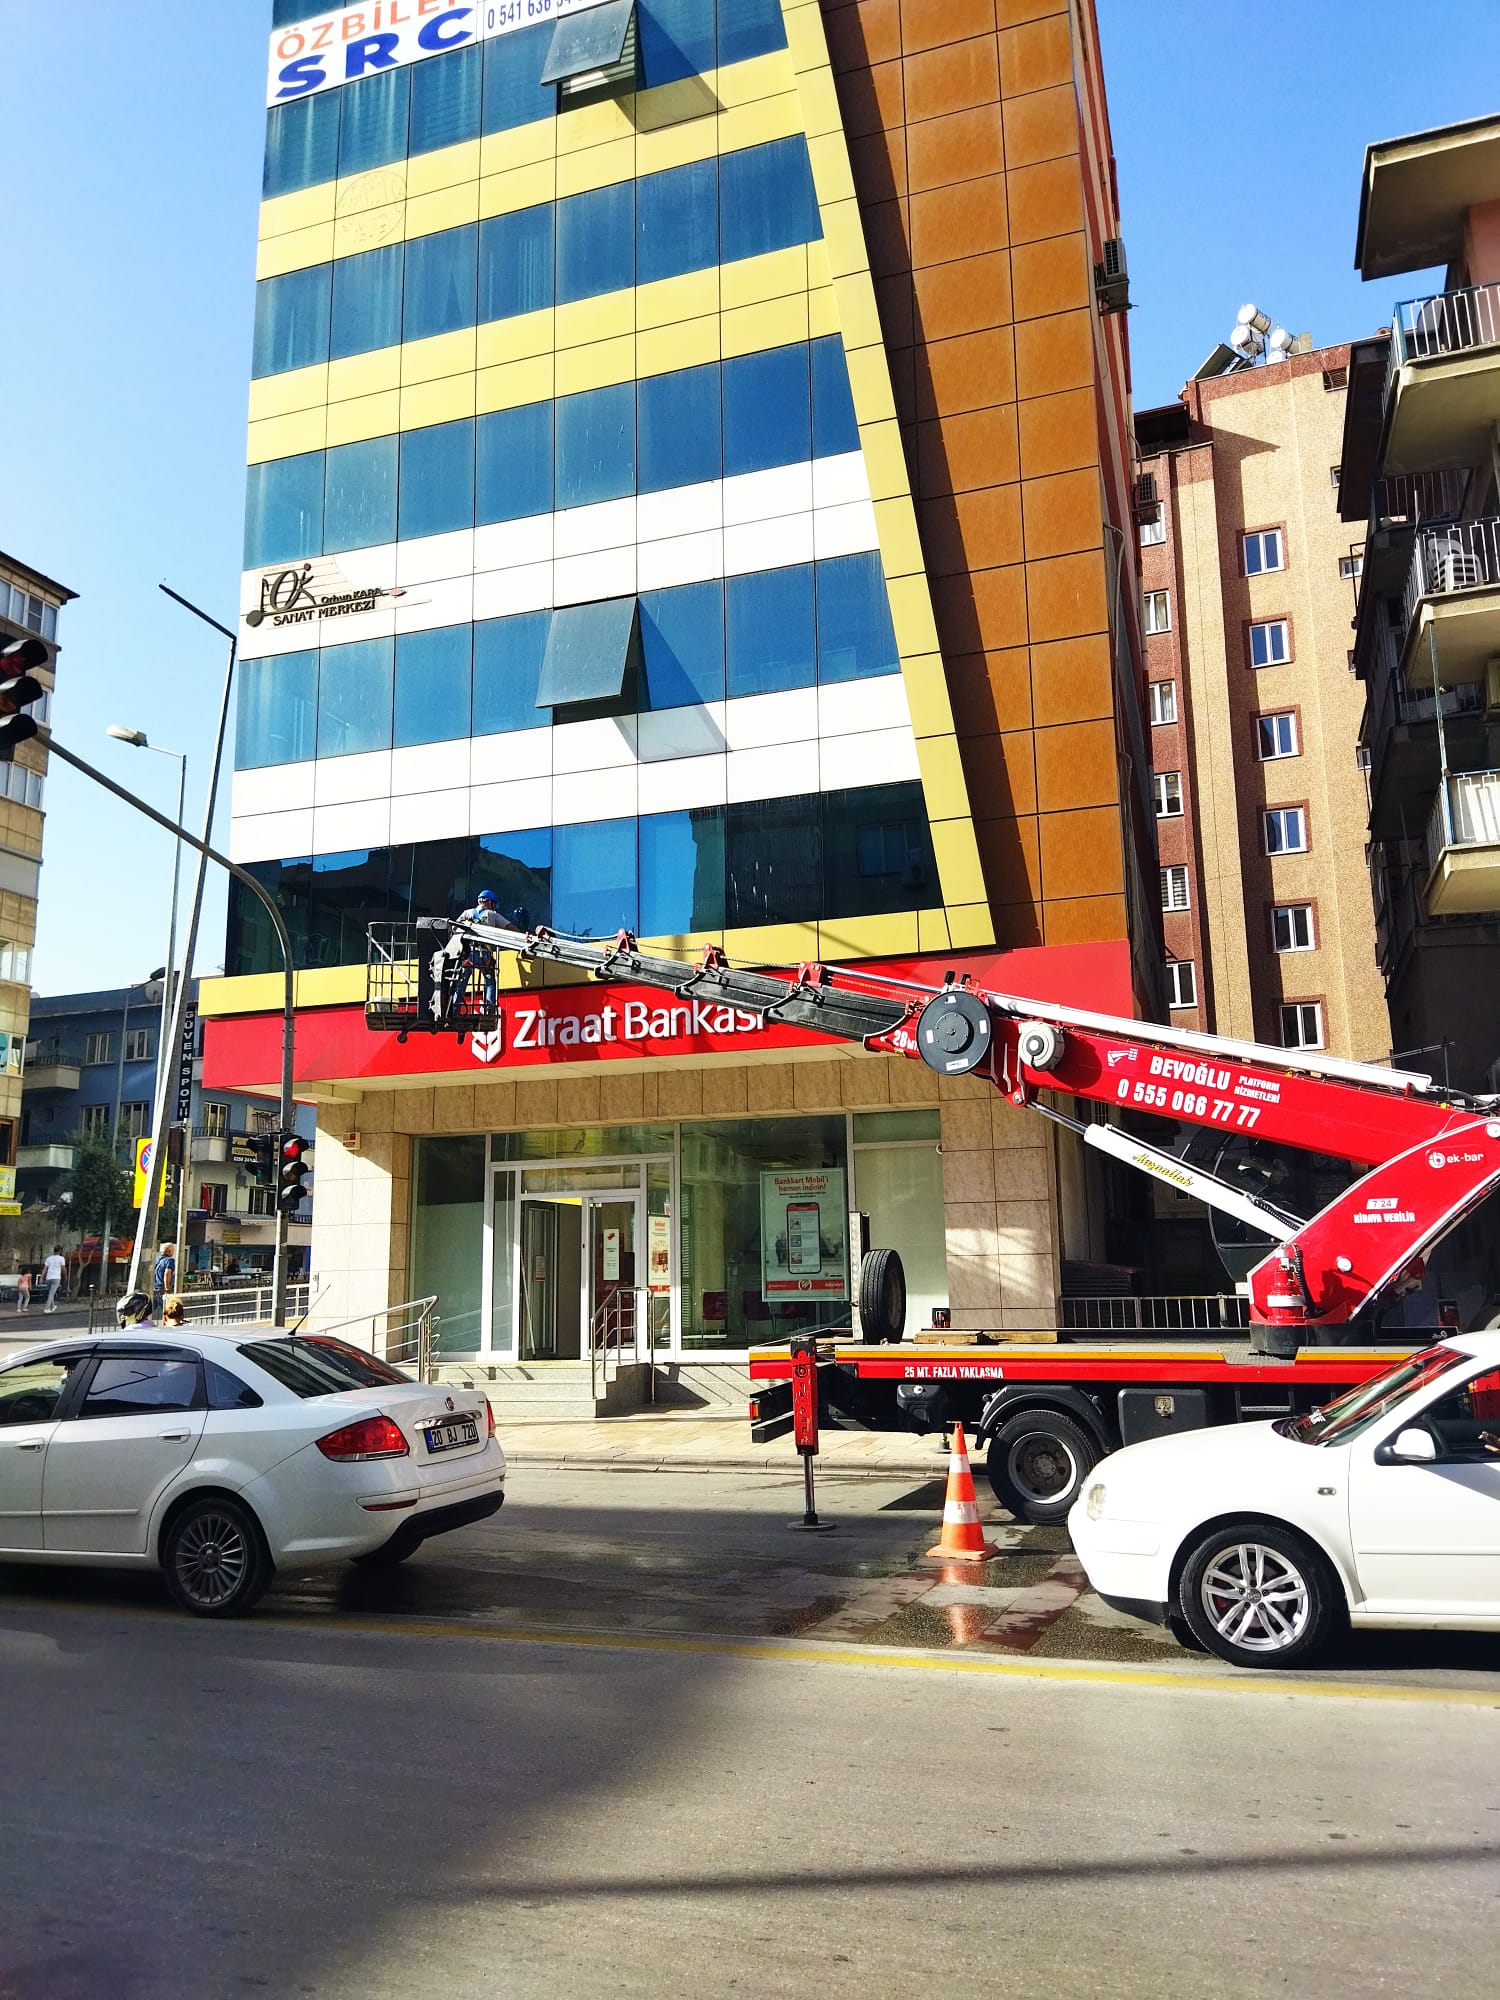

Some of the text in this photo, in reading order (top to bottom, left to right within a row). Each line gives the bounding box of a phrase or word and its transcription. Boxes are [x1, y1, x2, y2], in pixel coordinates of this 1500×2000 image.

[276, 0, 457, 59] ÖZBİLE
[487, 8, 495, 29] 0
[499, 1, 522, 26] 541
[275, 7, 474, 98] SRC
[272, 597, 376, 627] SANAT MERKEZİ
[182, 1011, 194, 1061] GÜVEN
[512, 999, 766, 1049] Ziraat Bankası
[1149, 1056, 1231, 1091] BEYOĞLU
[1238, 1075, 1281, 1092] PLATFORM
[1117, 1078, 1262, 1128] 0 555 066 77 77
[1233, 1086, 1281, 1104] HİZMETLERİ
[1446, 1152, 1485, 1164] ek-bar
[904, 1366, 915, 1378] 25
[916, 1366, 931, 1378] MT.
[933, 1366, 958, 1378] FAZLA
[431, 1430, 443, 1447] 20
[446, 1427, 458, 1444] BJ
[462, 1423, 476, 1441] 720
